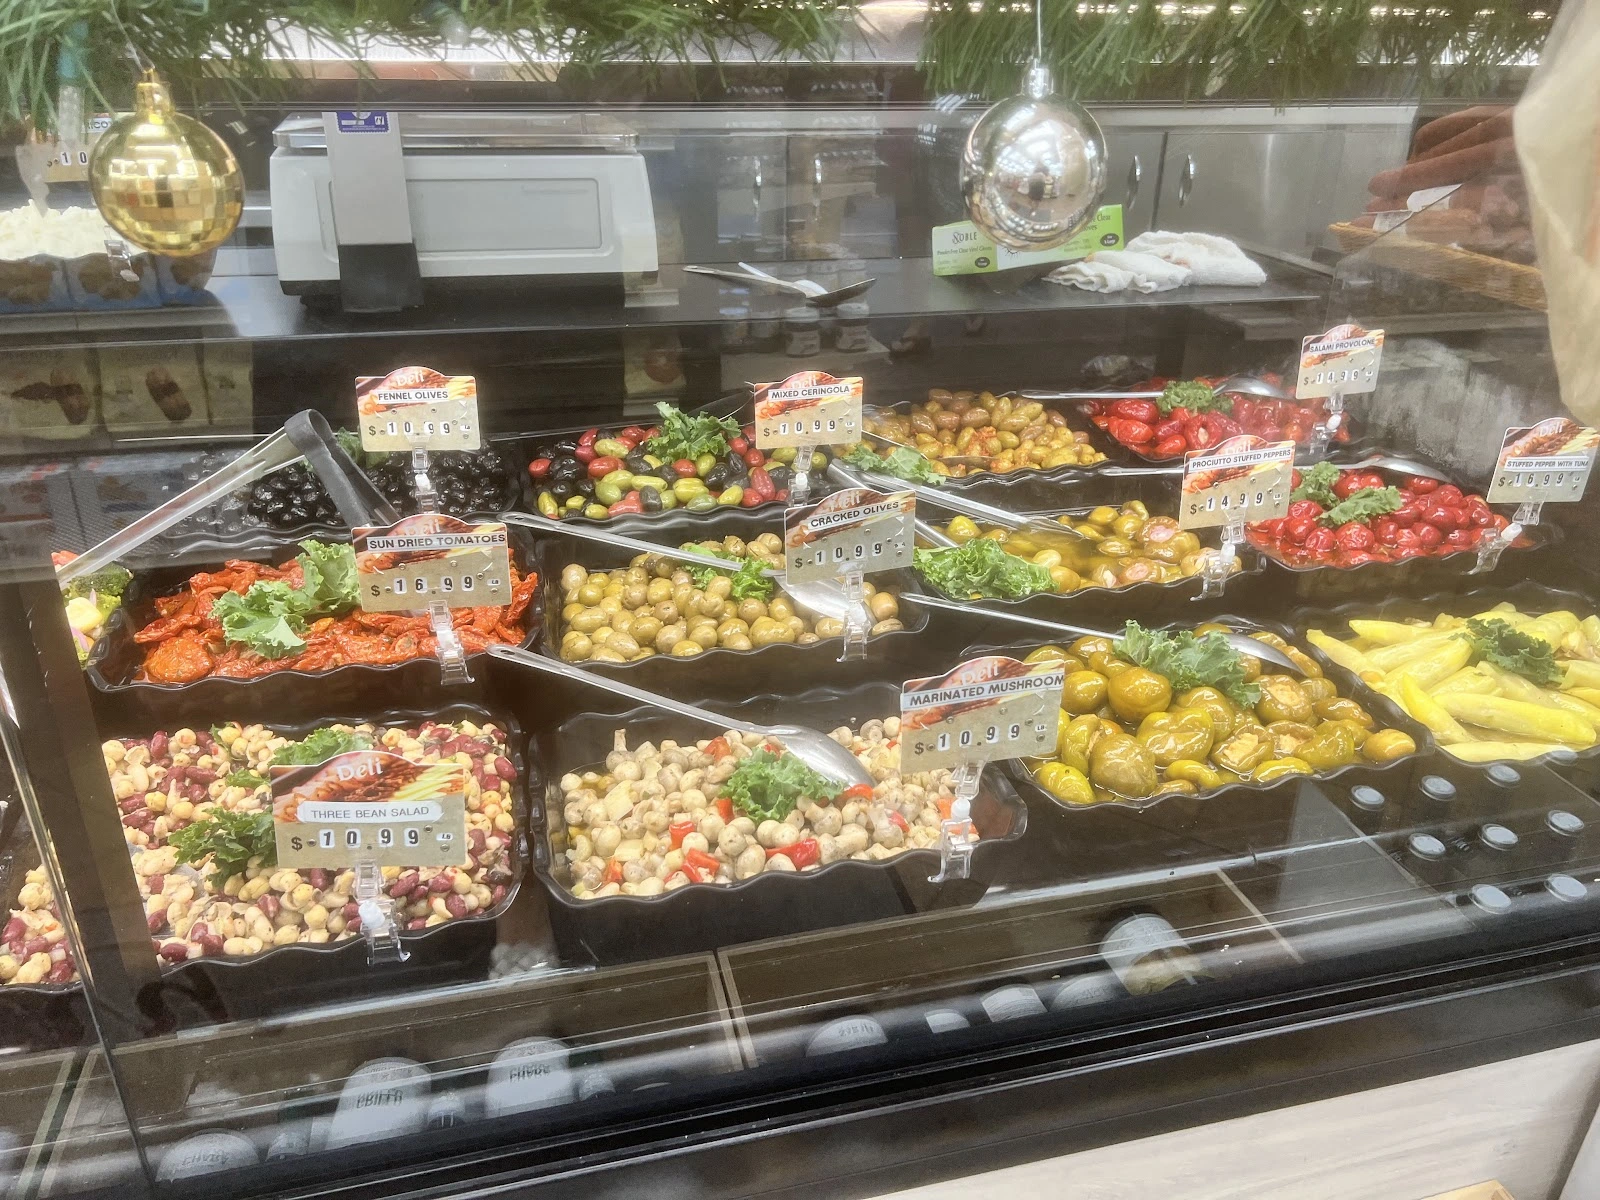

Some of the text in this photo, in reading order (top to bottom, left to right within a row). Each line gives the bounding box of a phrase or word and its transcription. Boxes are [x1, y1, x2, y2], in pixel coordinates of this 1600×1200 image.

[1309, 338, 1376, 353] SALAMI PROVOLONE
[396, 368, 425, 387] Deli
[377, 390, 449, 401] FENNEL OLIVES
[771, 385, 851, 399] MIXED CERINGOLA
[1192, 449, 1292, 469] PROCIUTTO STUFFED PEPPERS
[1506, 460, 1534, 468] STUFFED
[1534, 460, 1556, 468] PEPPER
[810, 501, 900, 528] CRACKED OLIVES
[369, 533, 506, 549] SUN DRIED TOMATOES
[959, 660, 1000, 687] Deli
[909, 673, 1064, 707] MARINATED MUSHROOM
[335, 756, 385, 782] Deli
[310, 805, 430, 819] THREE BEAN SALAD
